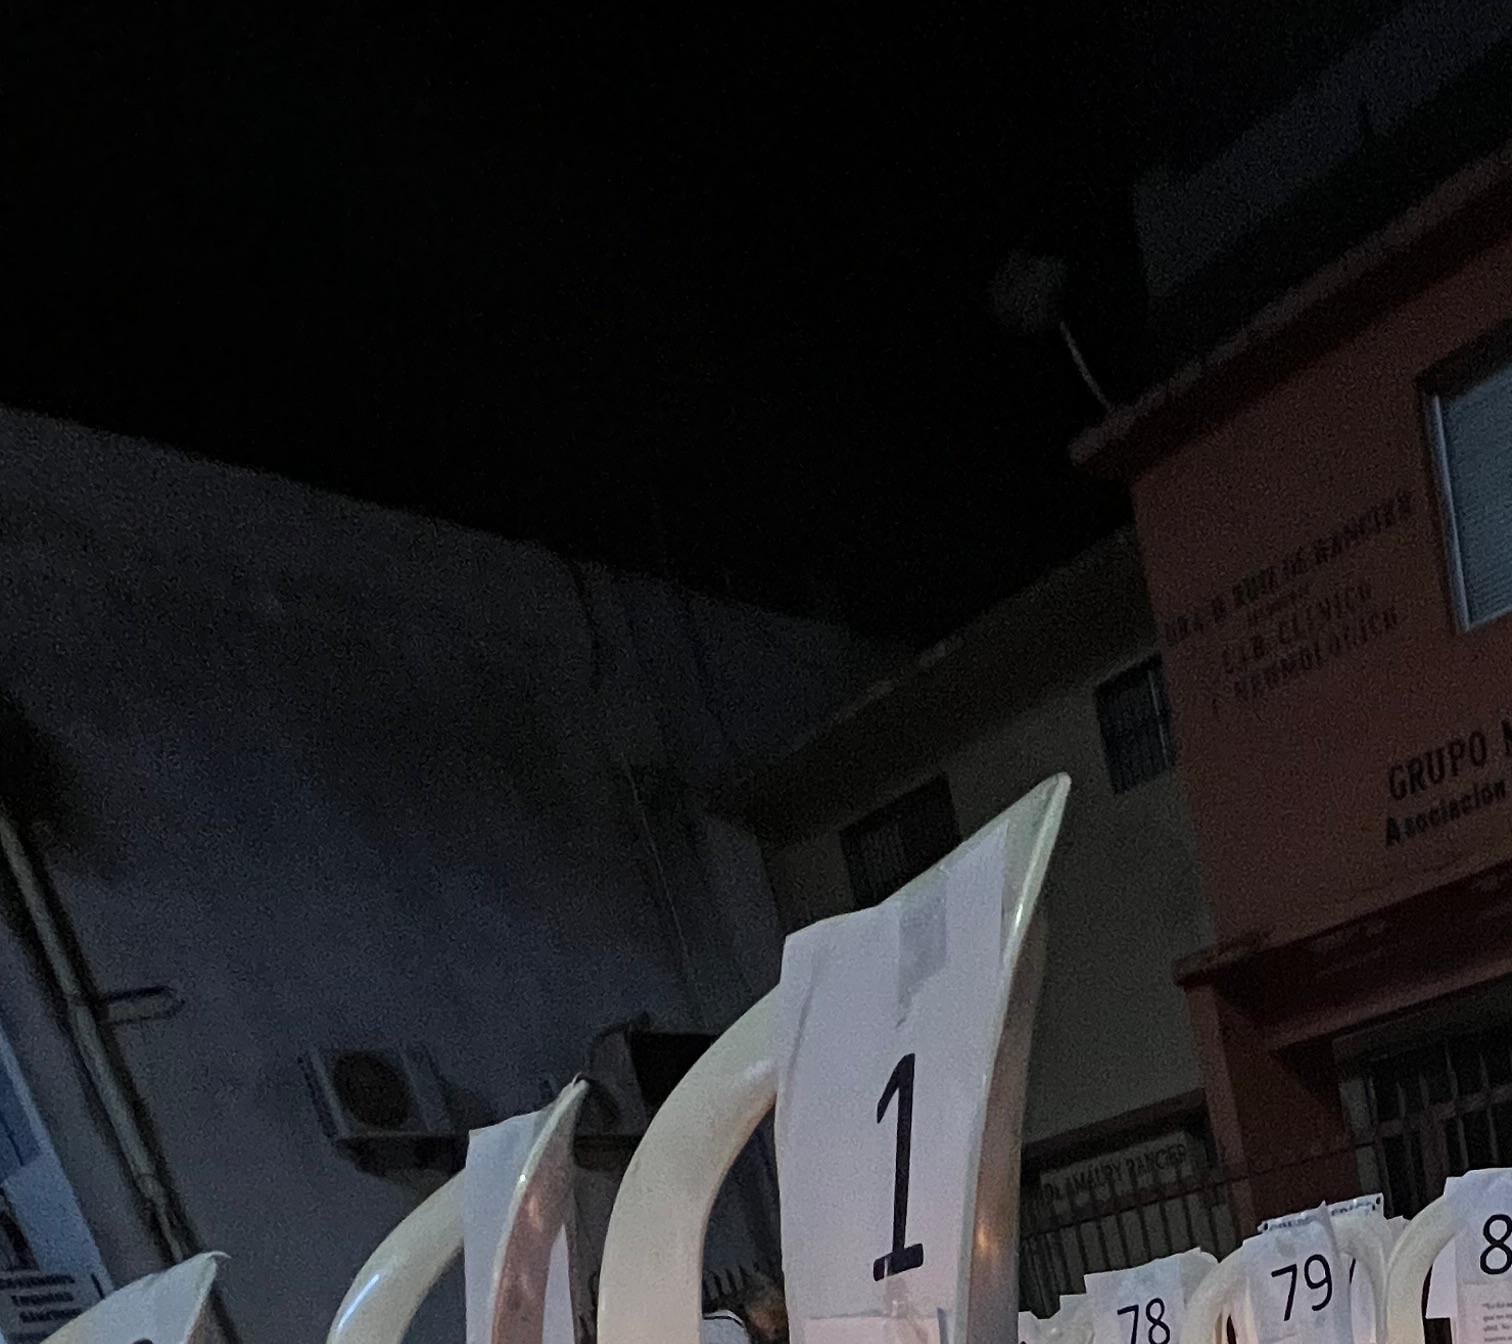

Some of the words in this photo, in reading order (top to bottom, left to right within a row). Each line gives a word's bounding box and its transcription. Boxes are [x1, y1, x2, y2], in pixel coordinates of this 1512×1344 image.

[1387, 729, 1488, 802] GRUPO
[872, 1051, 925, 1282] 1
[1270, 1252, 1335, 1324] 79
